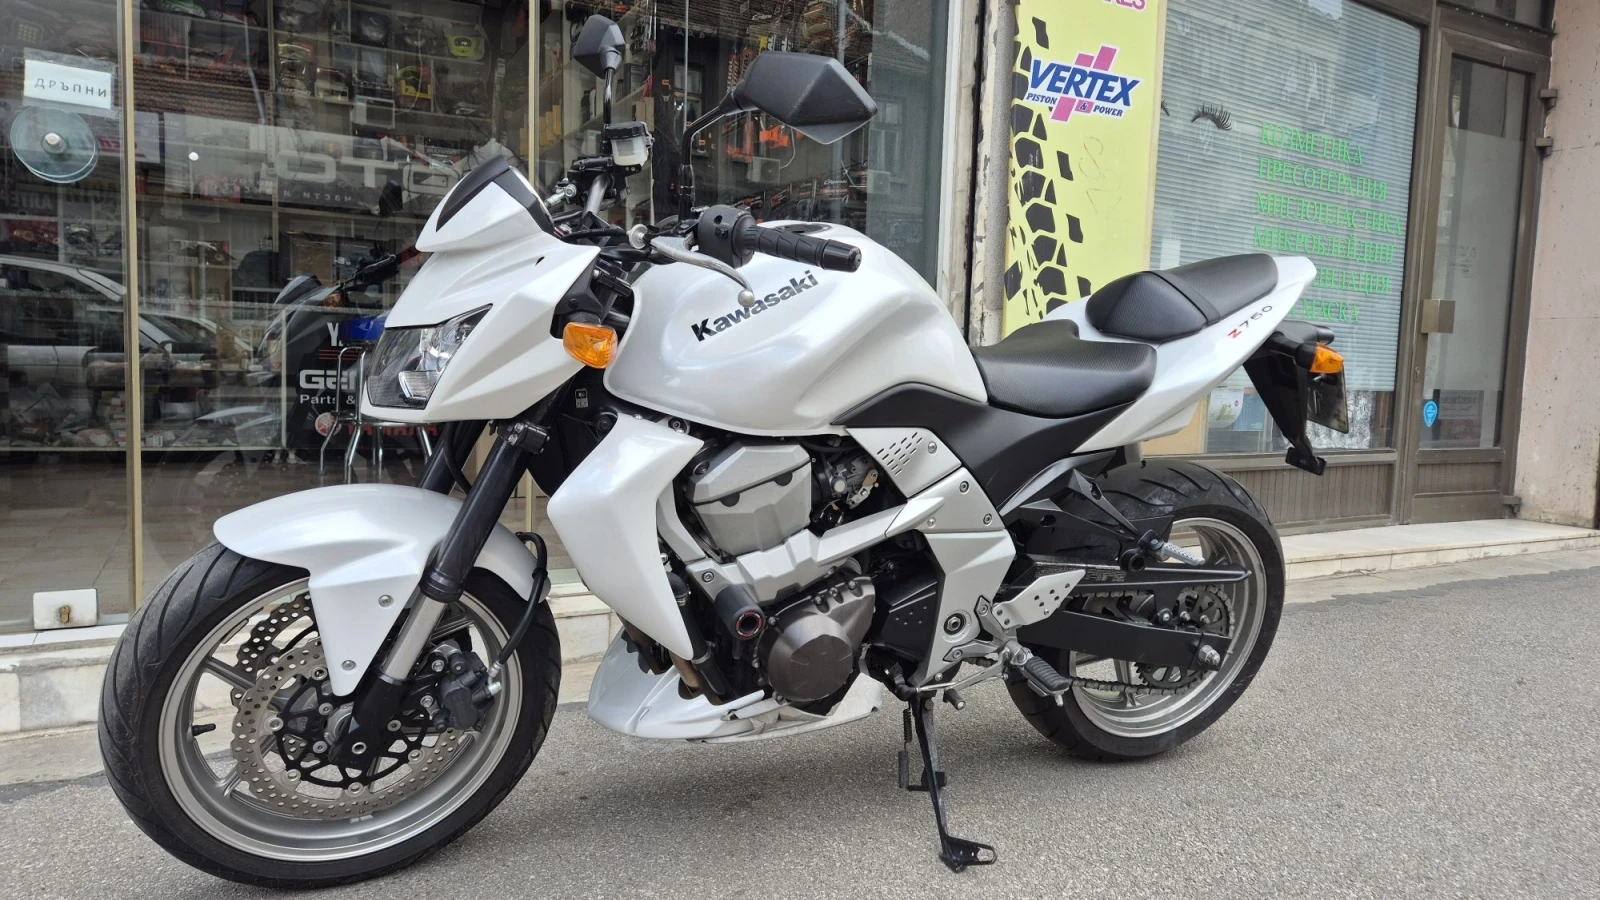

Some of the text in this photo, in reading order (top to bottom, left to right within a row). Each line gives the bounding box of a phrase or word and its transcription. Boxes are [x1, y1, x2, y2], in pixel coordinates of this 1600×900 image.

[34, 78, 107, 97] ДРЪПНИ
[1026, 92, 1123, 117] PISTON & POWER
[1030, 59, 1140, 107] VERTEX
[1260, 121, 1364, 166] КОЗМЕТИКА
[1258, 156, 1389, 202] ПРЕСОТЕРАПИЯ
[1256, 192, 1402, 236] МИГЛОПЛАСТИКА
[691, 270, 818, 342] Kawasaki
[1302, 297, 1360, 323] МАСКА
